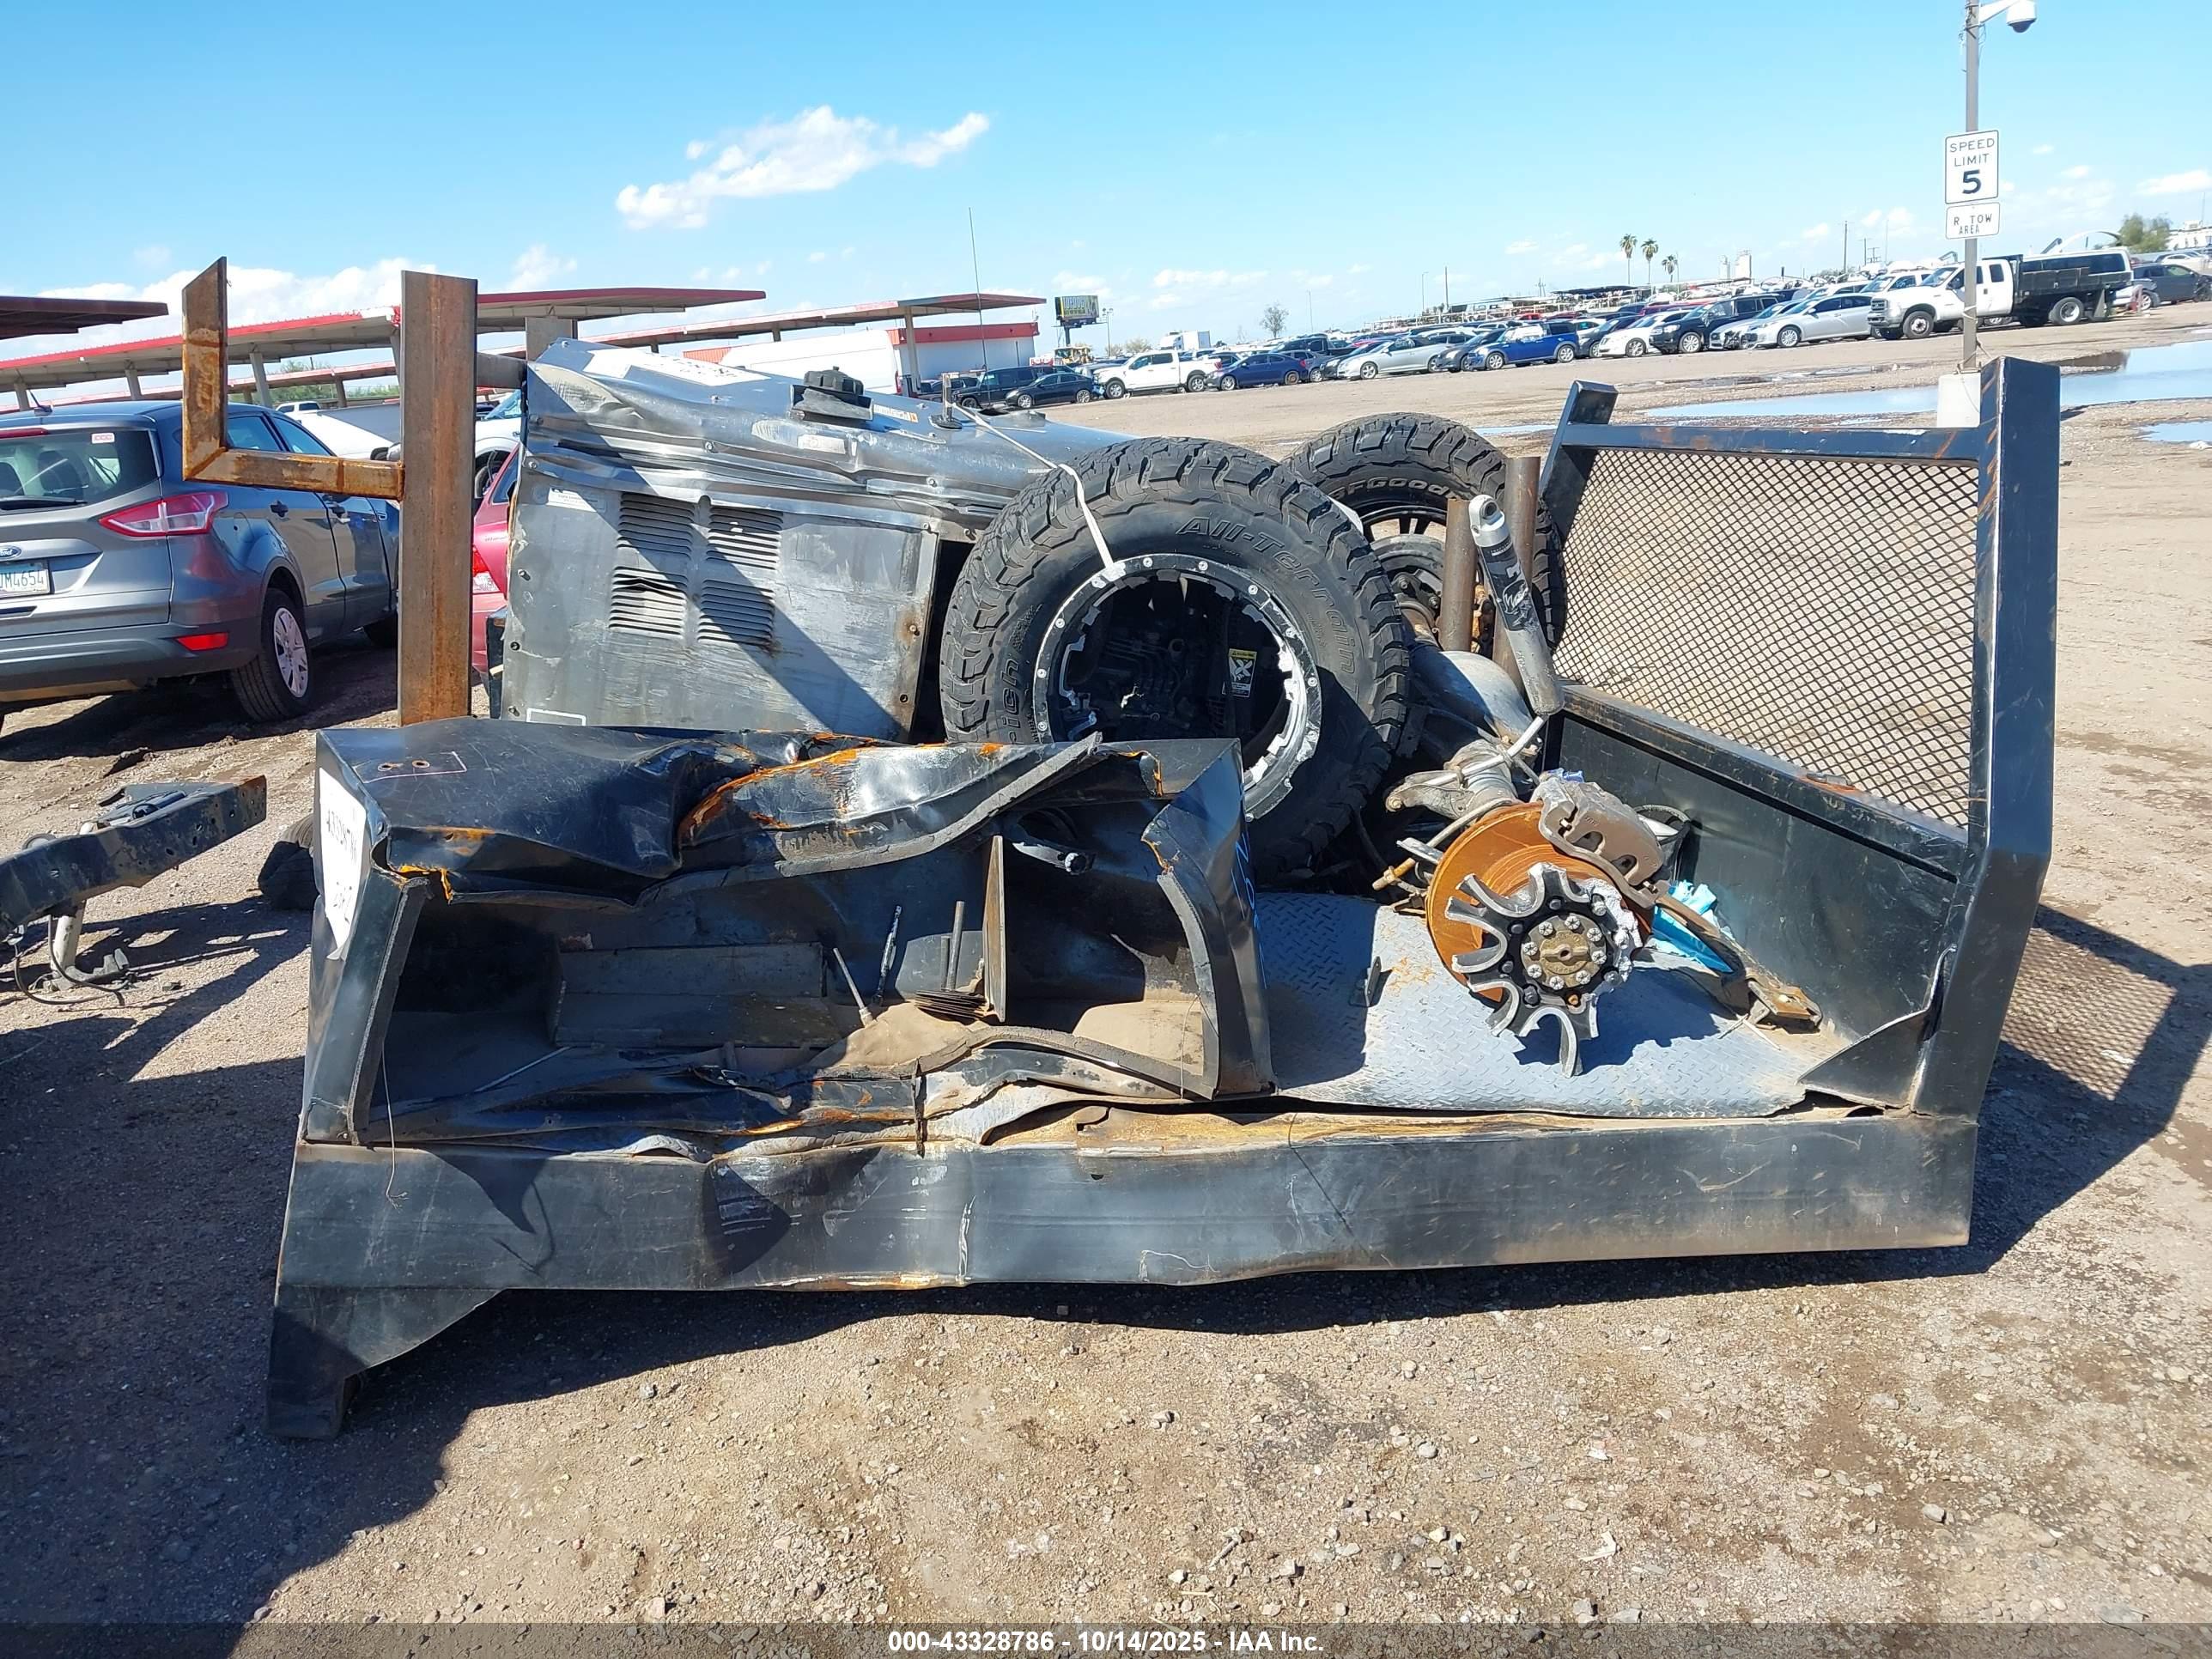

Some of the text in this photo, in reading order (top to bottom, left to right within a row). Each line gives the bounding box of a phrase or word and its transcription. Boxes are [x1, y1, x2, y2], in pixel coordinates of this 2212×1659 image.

[1950, 137, 1995, 153] SPEED
[1954, 153, 1990, 167] LIMIT
[1962, 169, 1982, 195] 5
[1970, 213, 1993, 224] TOW
[1959, 224, 1980, 235] AREA
[1176, 516, 1356, 674] All-Terrain
